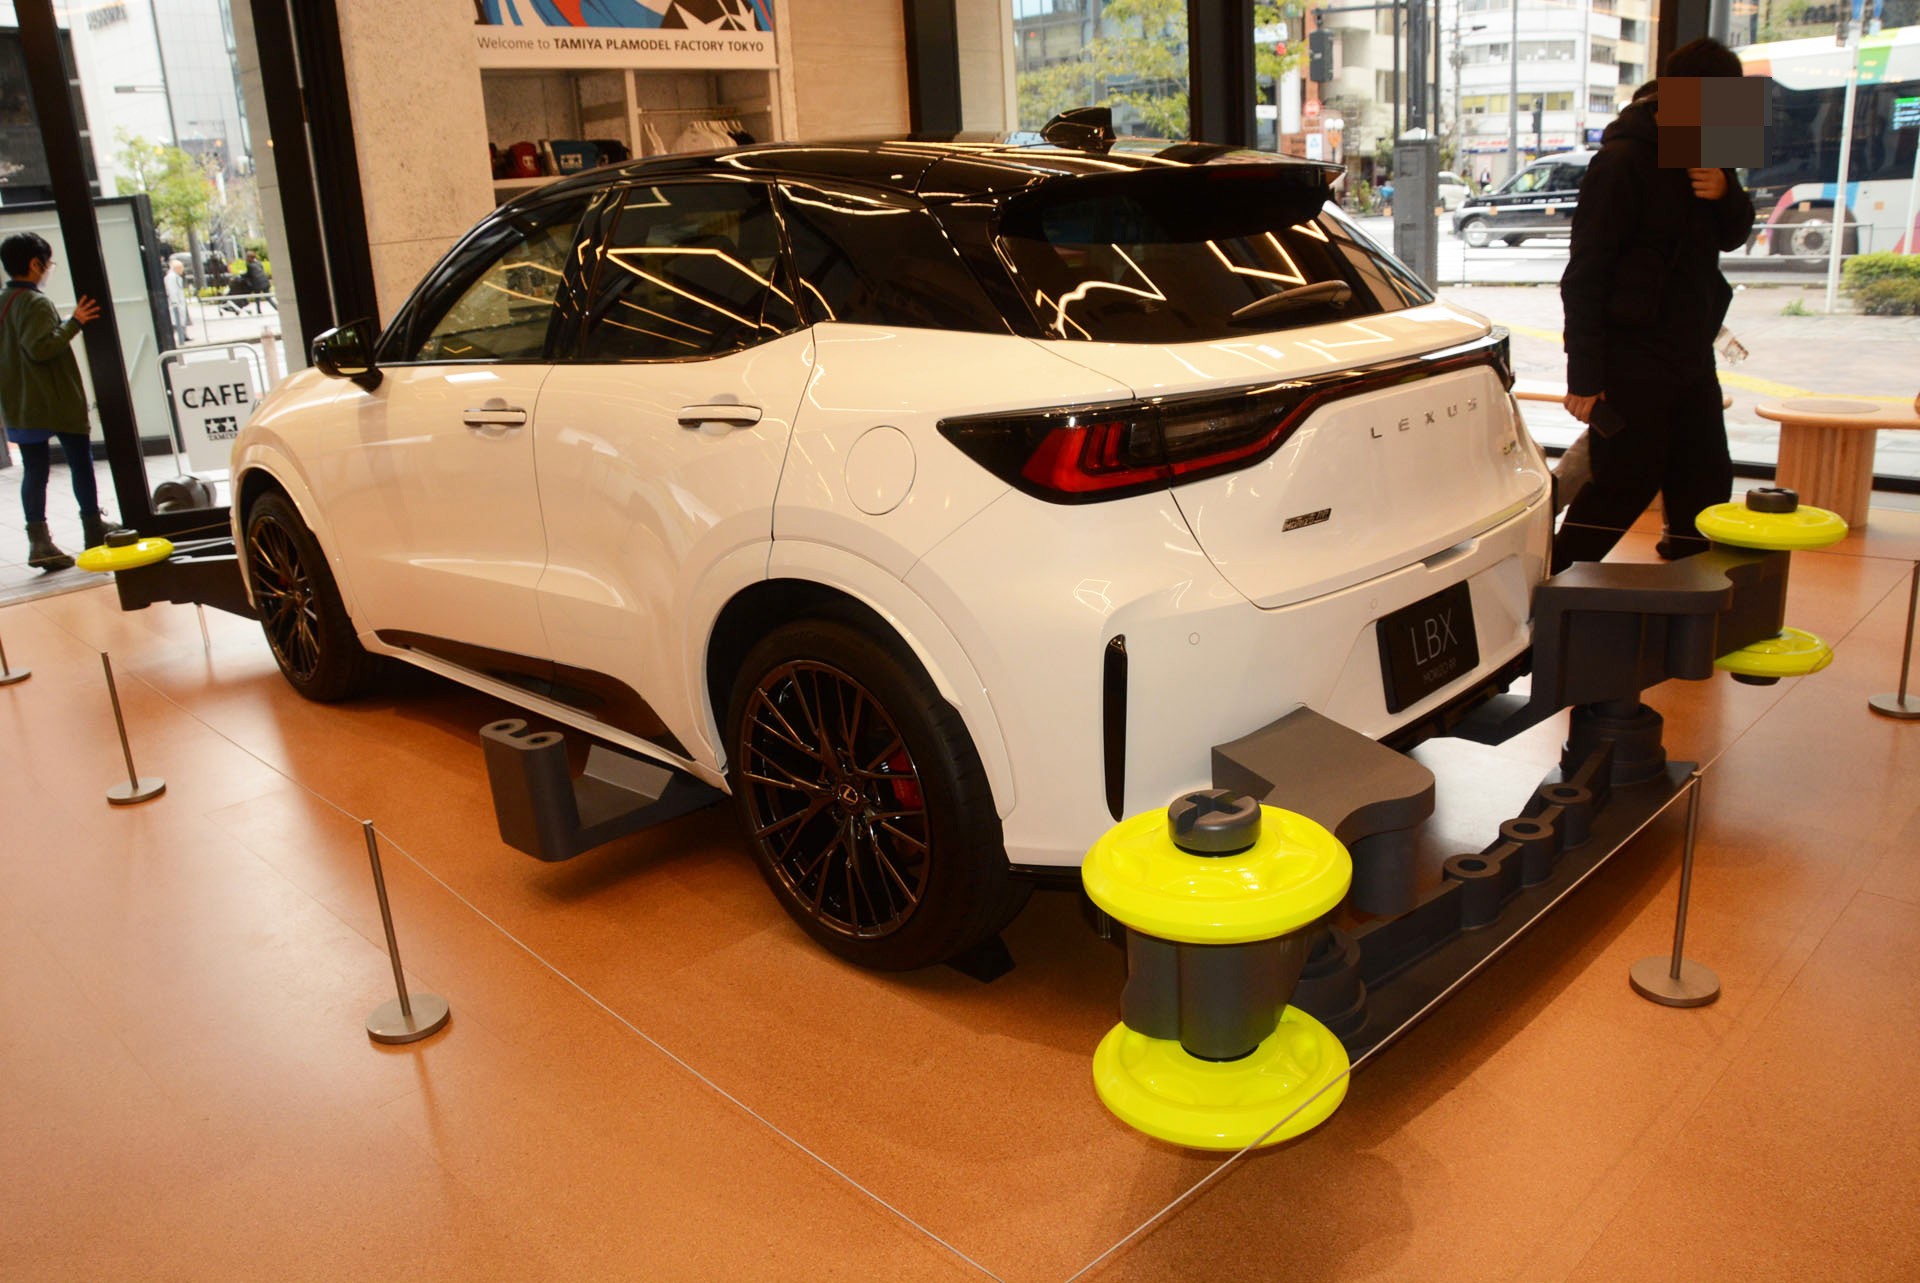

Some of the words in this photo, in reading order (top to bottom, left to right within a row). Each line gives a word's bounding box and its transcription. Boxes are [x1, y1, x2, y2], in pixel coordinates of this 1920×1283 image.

[477, 36, 535, 49] Welcome
[538, 38, 551, 49] to
[553, 38, 602, 50] TAMIYA
[606, 38, 671, 51] PLAMODEL
[674, 40, 724, 51] FACTORY
[727, 41, 764, 52] TOKYO
[182, 383, 248, 409] CAFE
[1370, 397, 1478, 440] LEXUS
[1411, 608, 1458, 666] LBX
